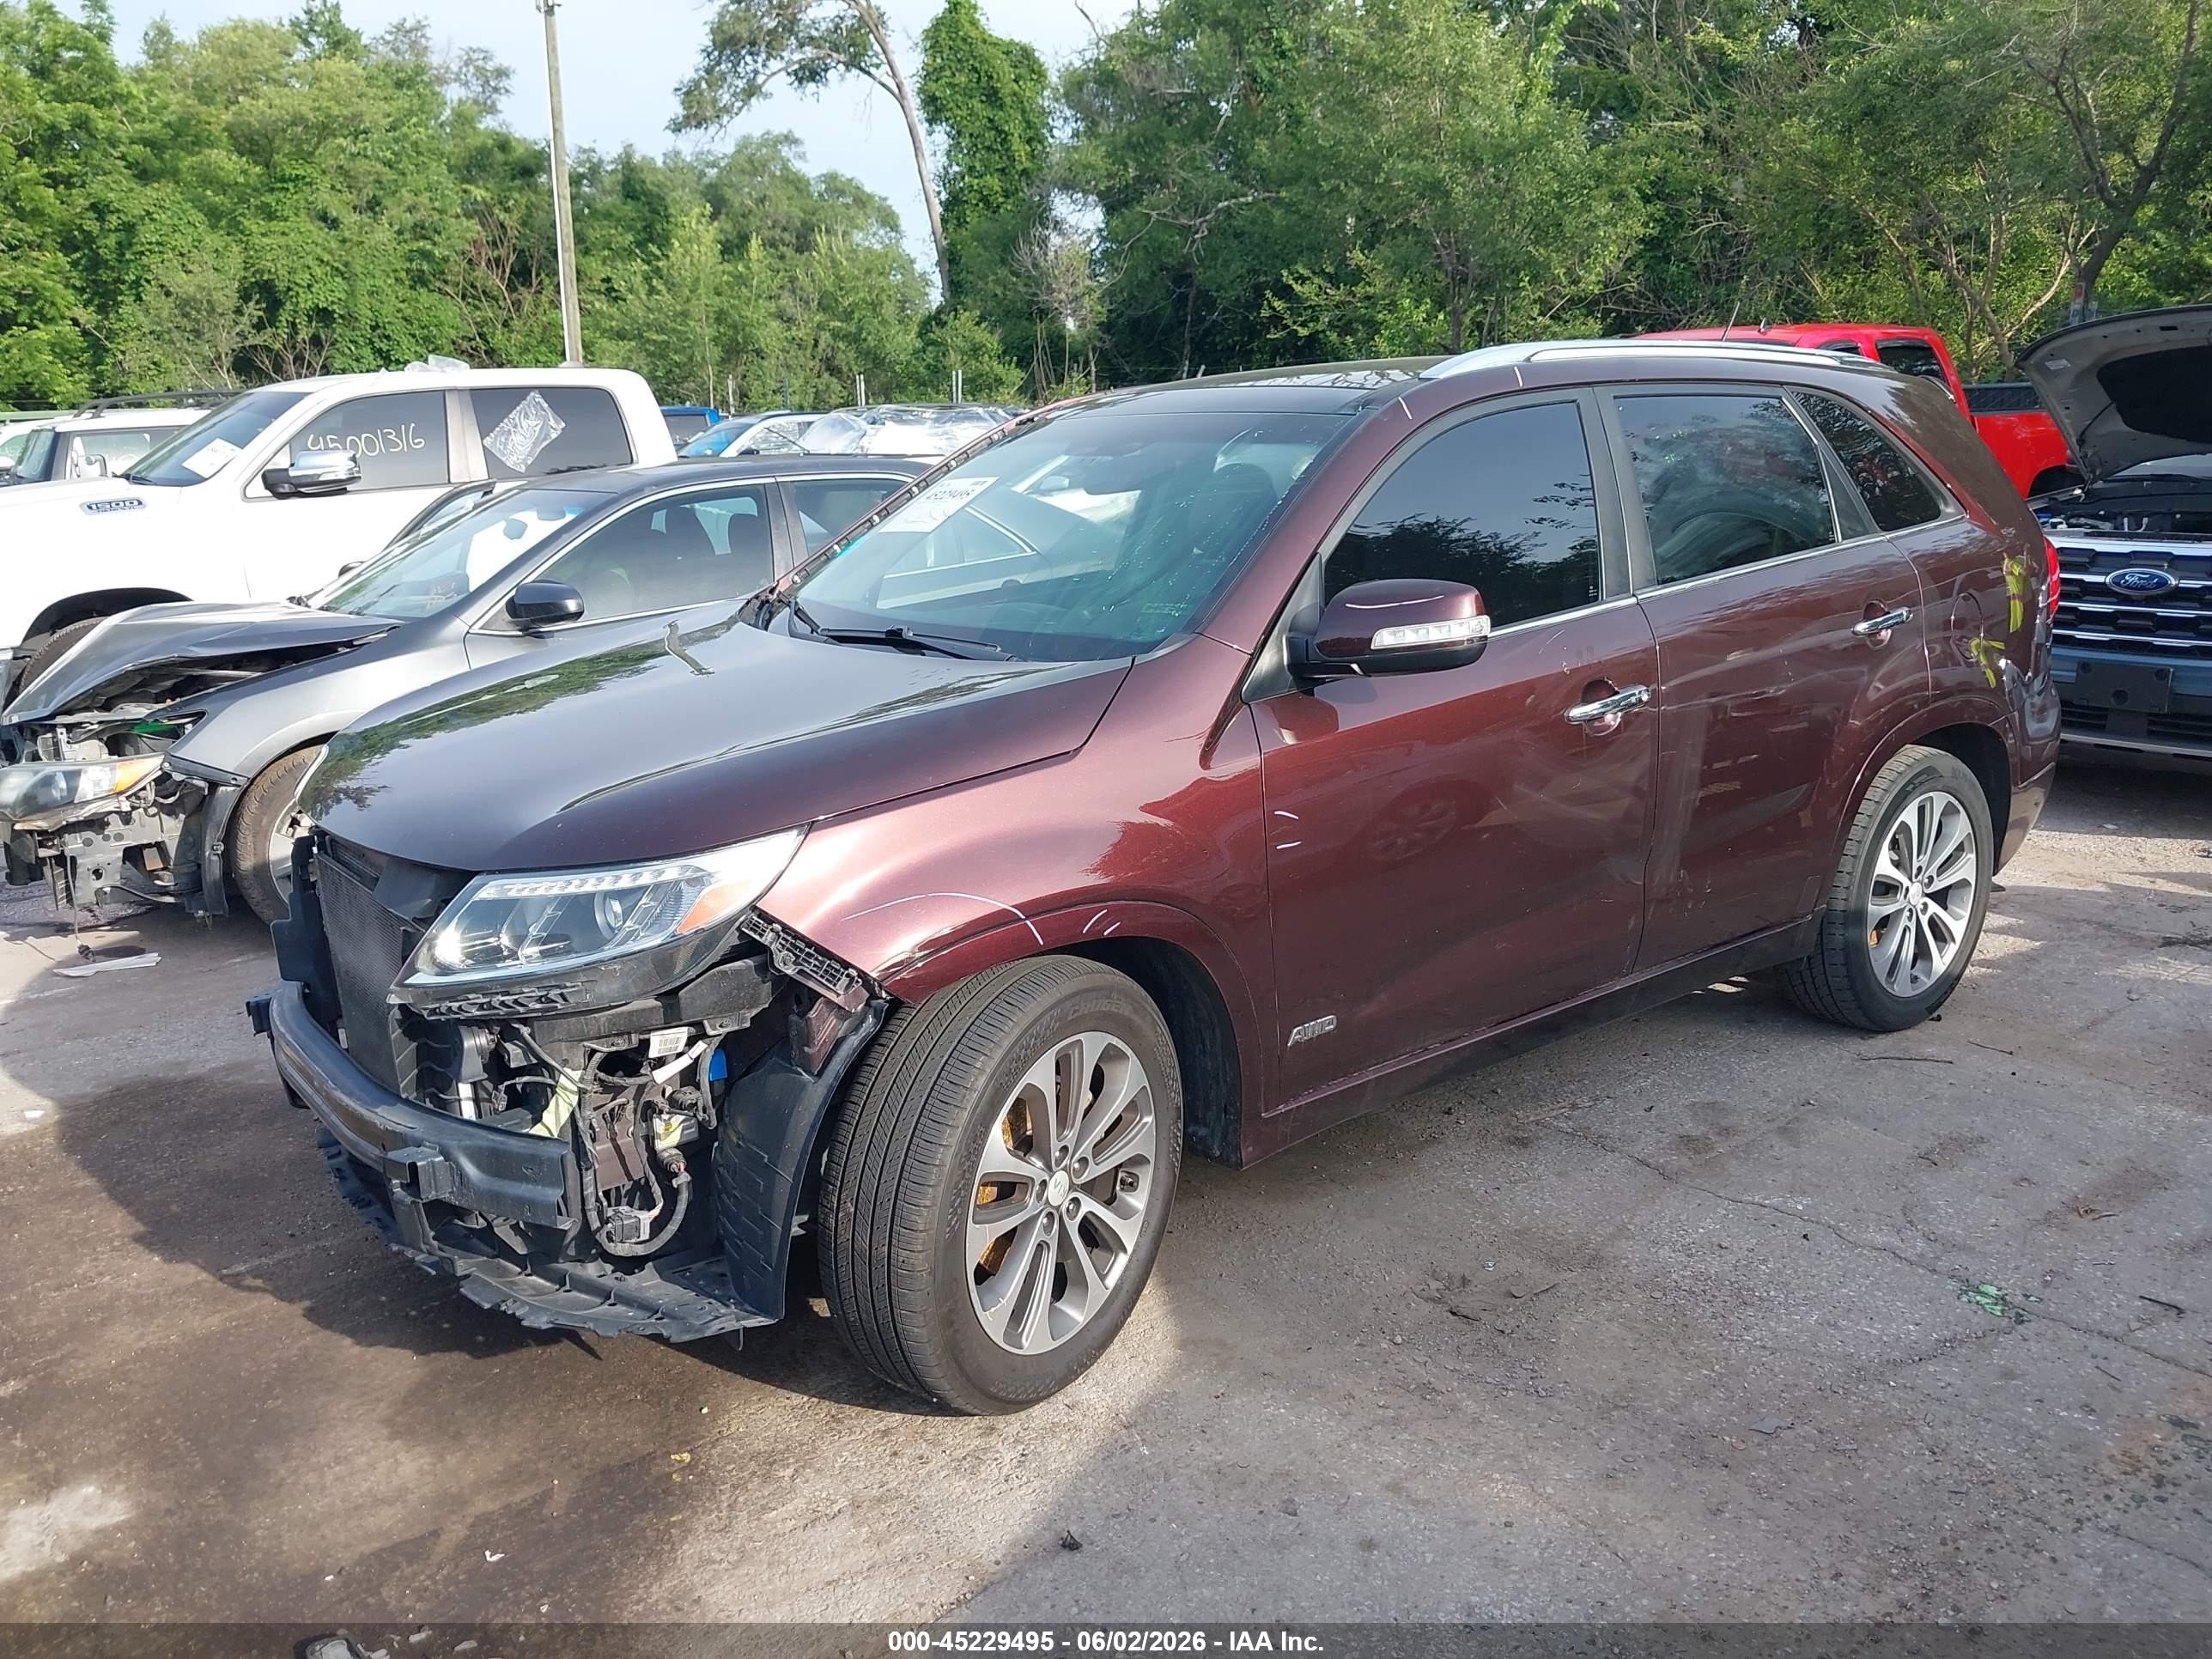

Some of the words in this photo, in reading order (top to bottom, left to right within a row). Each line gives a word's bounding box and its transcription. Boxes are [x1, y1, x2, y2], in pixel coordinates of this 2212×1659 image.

[87, 498, 143, 511] 1500
[2119, 572, 2160, 590] Ford
[1287, 1015, 1338, 1047] AWD
